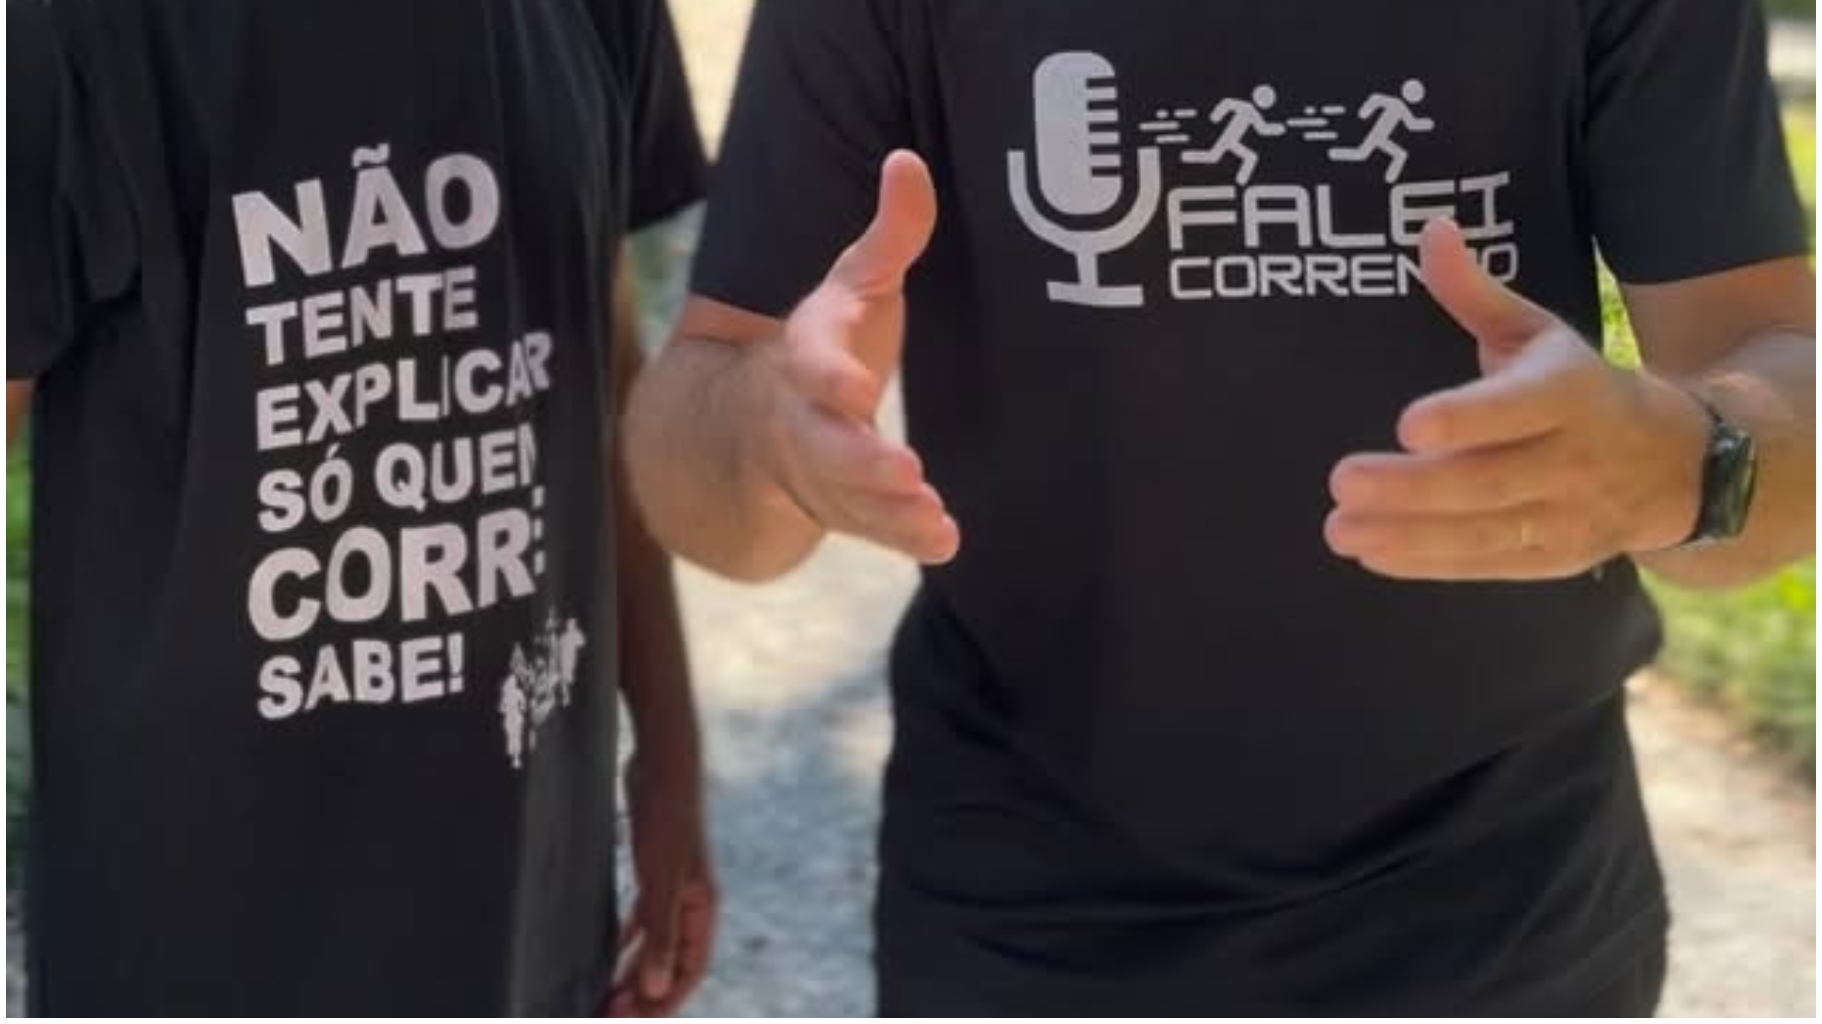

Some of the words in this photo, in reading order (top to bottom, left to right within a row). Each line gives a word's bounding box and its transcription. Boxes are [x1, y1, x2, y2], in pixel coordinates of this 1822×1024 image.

[231, 143, 500, 288] NÃO
[1167, 171, 1514, 251] FALEI
[245, 266, 479, 366] TENTE
[1169, 242, 1518, 300] CORRENO
[256, 331, 554, 451] EXPLICAR
[258, 443, 353, 533] SÓ
[257, 633, 465, 719] SABE!
